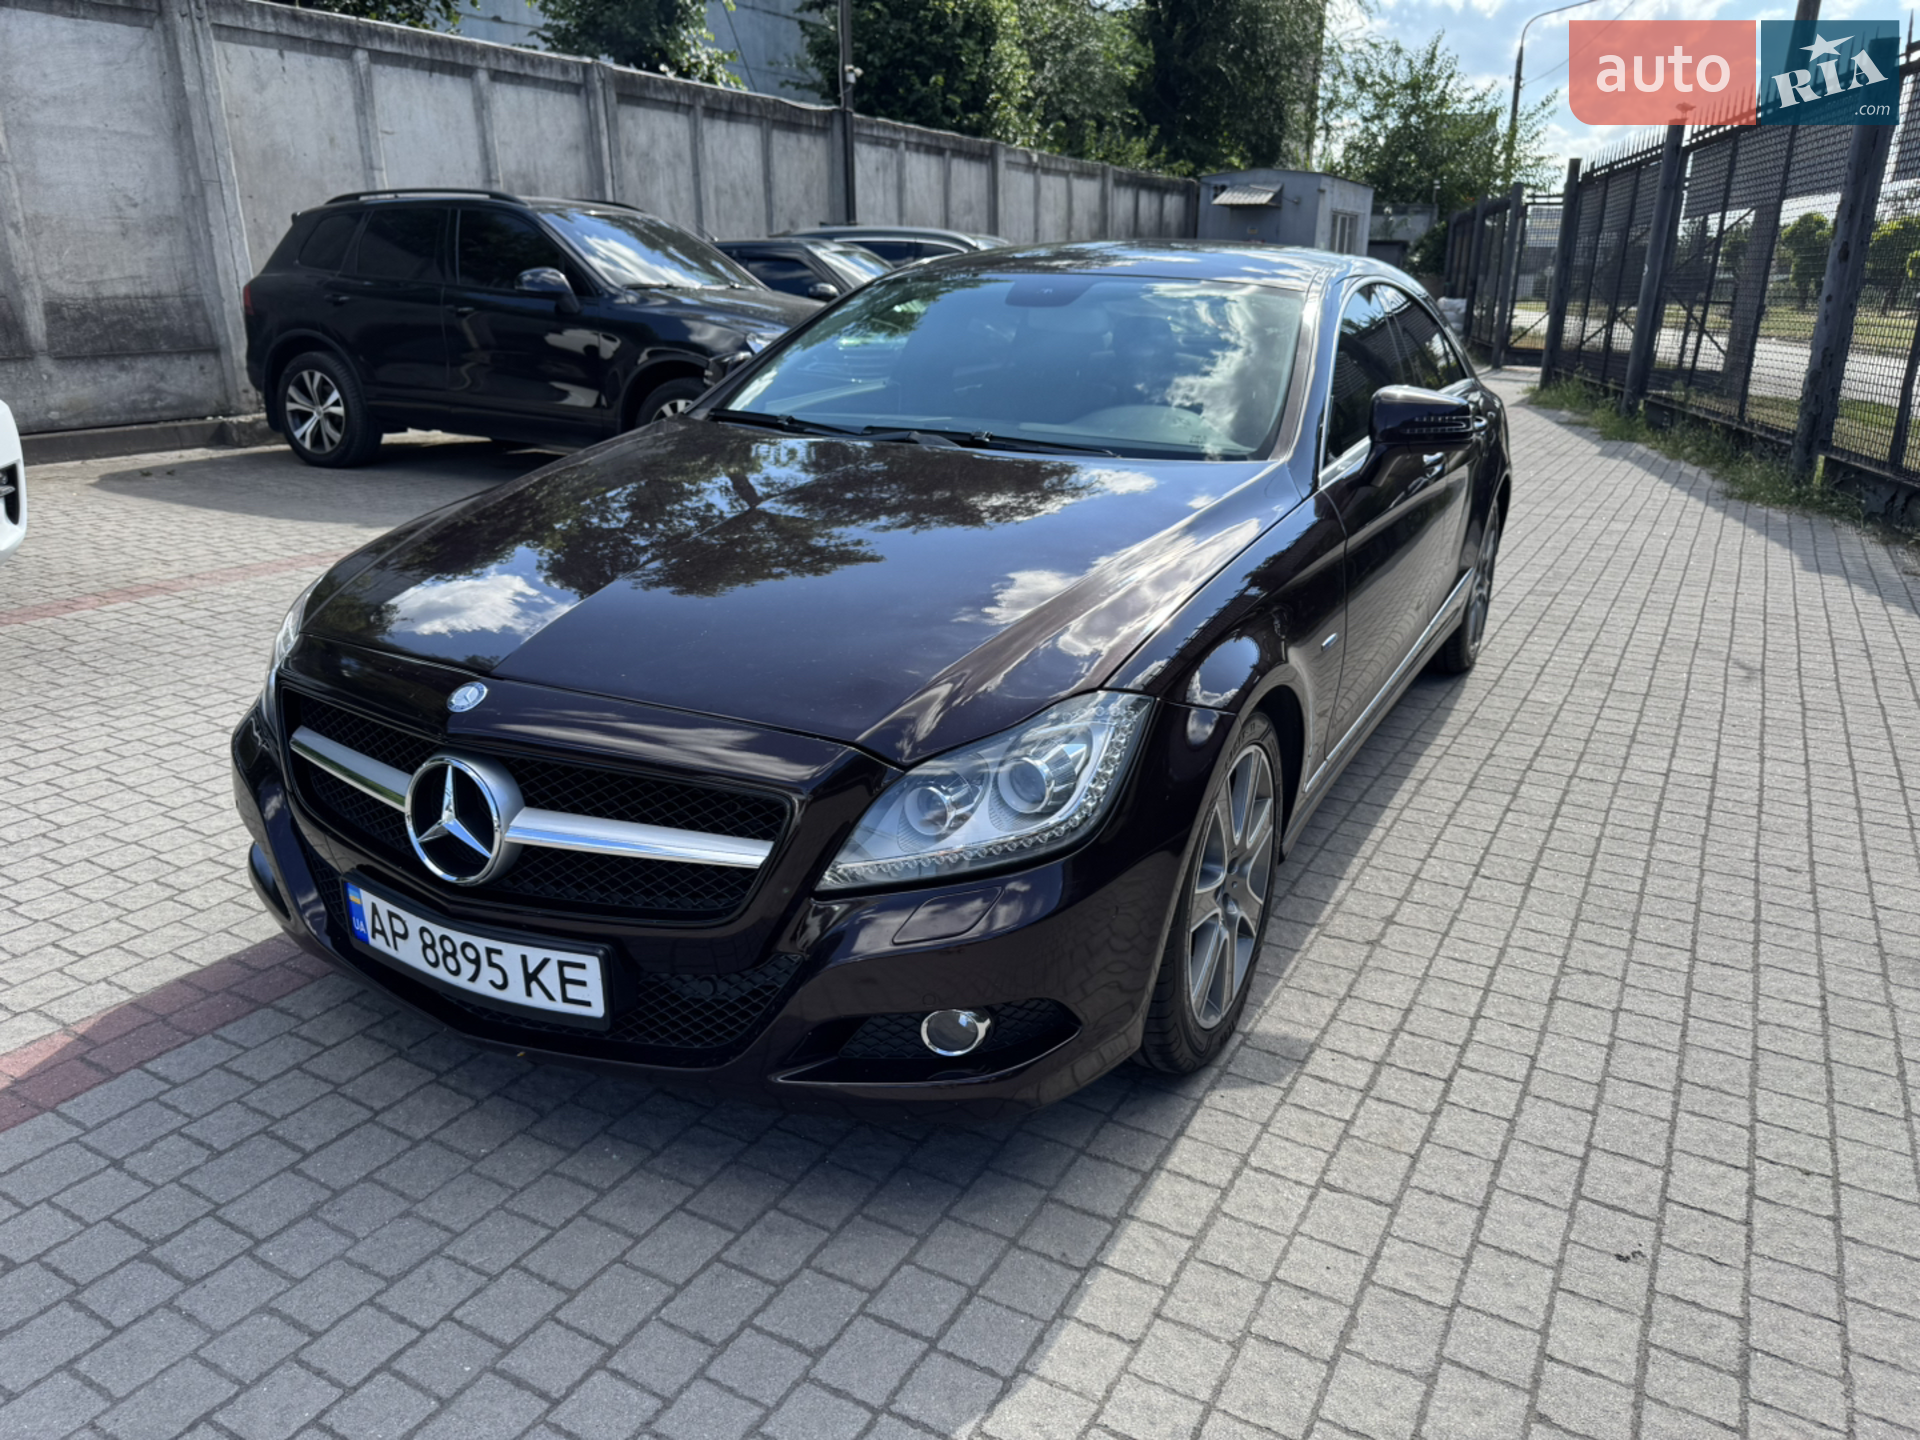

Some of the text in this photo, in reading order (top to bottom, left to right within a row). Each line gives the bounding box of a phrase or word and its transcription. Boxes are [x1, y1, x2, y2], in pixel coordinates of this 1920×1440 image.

[352, 916, 367, 934] UA
[370, 902, 592, 1007] AP 8895 KE
